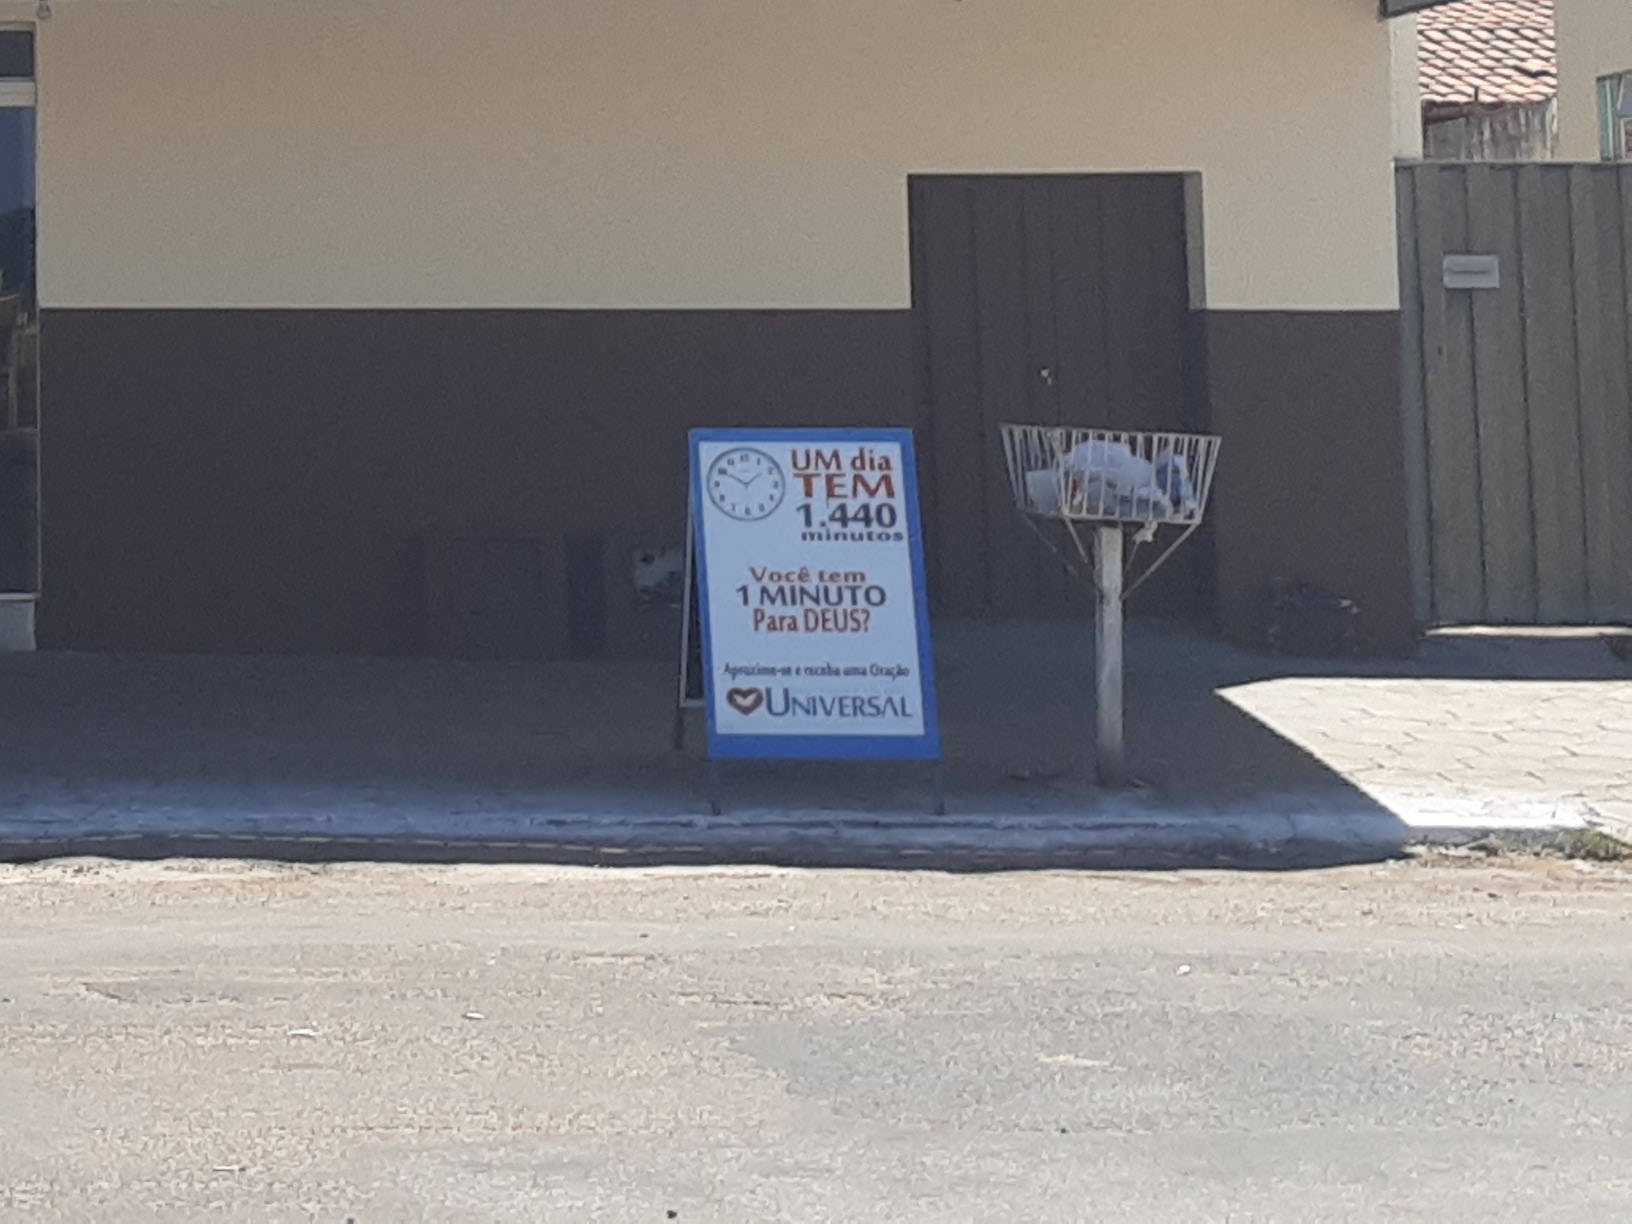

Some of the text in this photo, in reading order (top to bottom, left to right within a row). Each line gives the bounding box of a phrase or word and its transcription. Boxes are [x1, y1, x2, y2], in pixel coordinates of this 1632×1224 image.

[791, 447, 893, 471] UM dia
[793, 473, 896, 499] TEM
[796, 502, 897, 528] 1.440
[801, 528, 904, 542] minutos
[749, 566, 866, 583] Você tem
[736, 584, 887, 607] 1 MINUTO
[753, 608, 871, 633] Para DEUS?
[765, 687, 913, 717] UNIVERSAL
